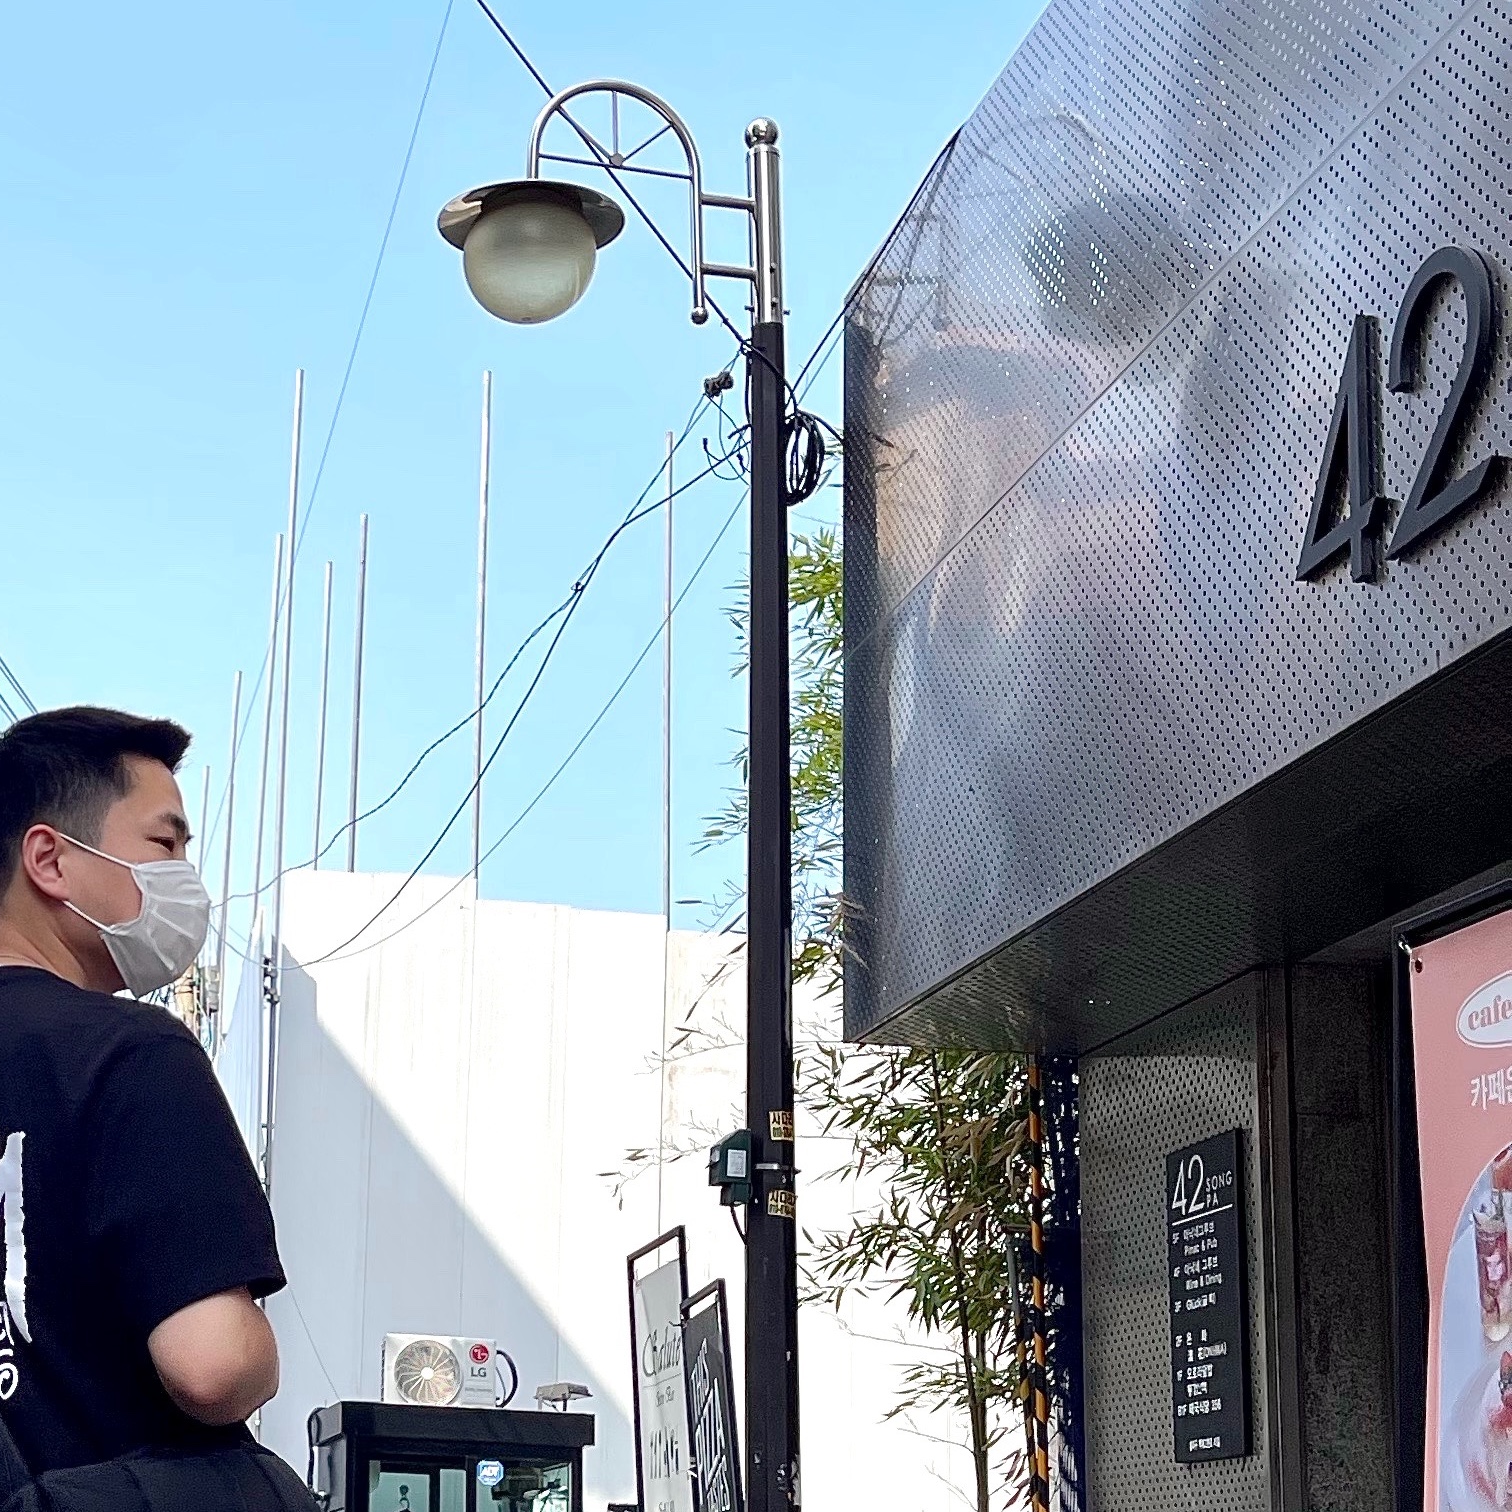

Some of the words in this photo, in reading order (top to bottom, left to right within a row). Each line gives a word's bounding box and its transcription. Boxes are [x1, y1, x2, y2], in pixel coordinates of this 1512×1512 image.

[1296, 246, 1512, 584] 42
[1172, 1154, 1204, 1216] 42
[1205, 1170, 1232, 1192] SONG
[1206, 1192, 1219, 1208] PA
[470, 1367, 487, 1378] LG
[694, 1376, 726, 1506] PIZZA
